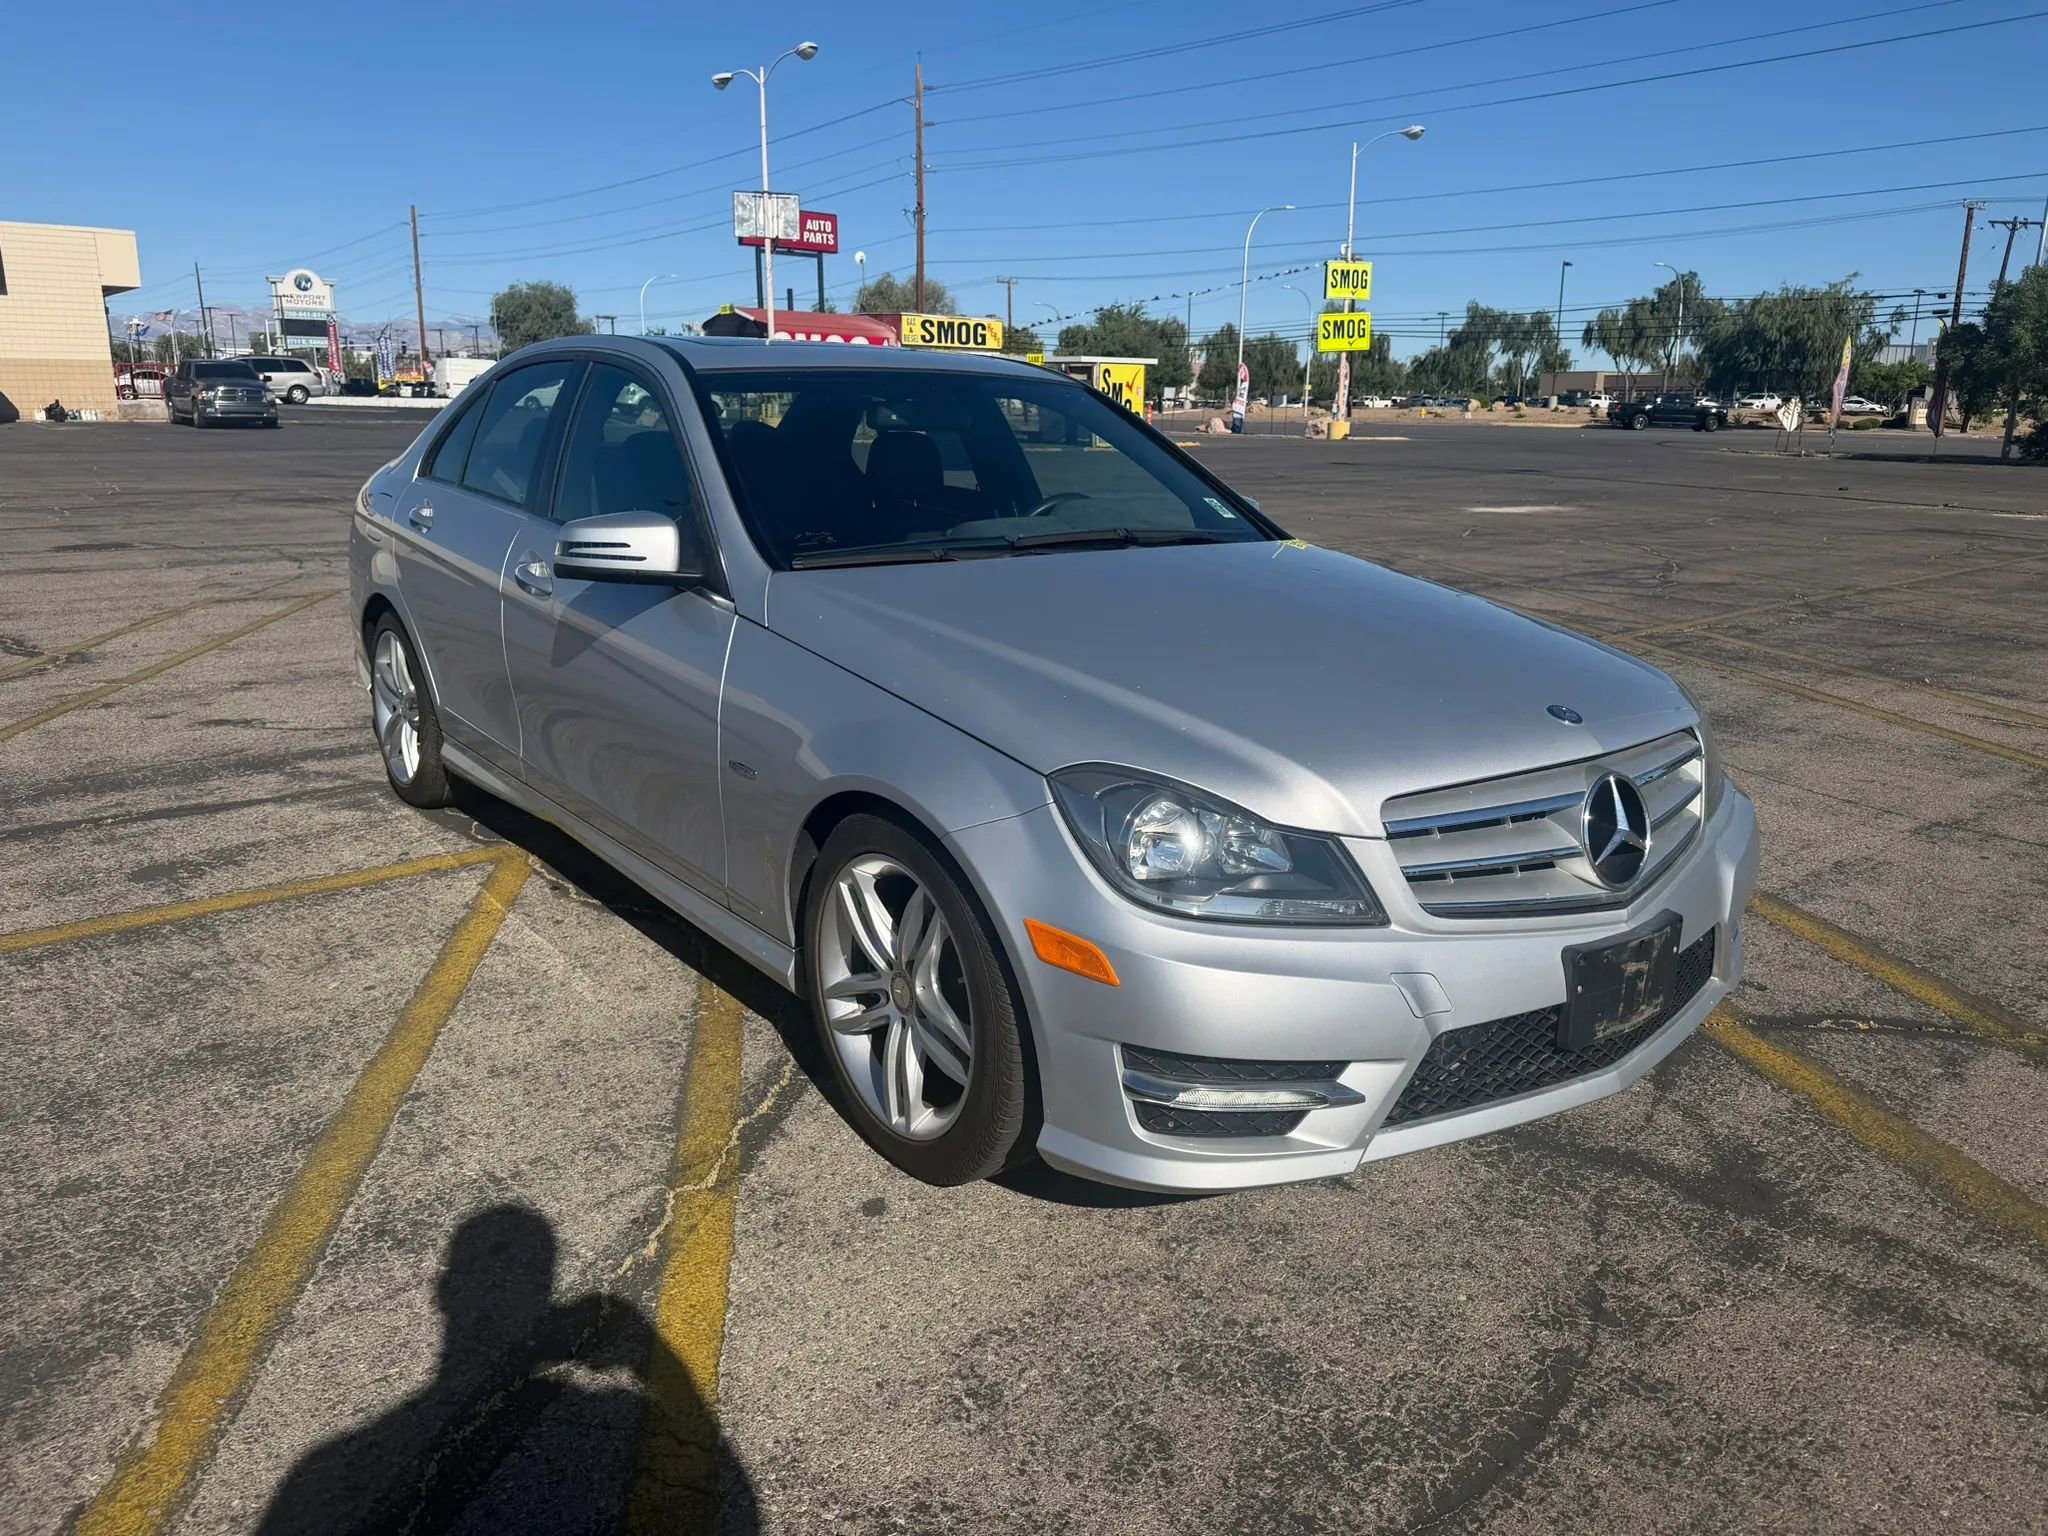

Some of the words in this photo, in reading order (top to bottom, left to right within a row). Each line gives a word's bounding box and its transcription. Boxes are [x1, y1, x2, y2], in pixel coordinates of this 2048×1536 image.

[806, 219, 832, 232] AUTO
[803, 231, 835, 245] PARTS
[1331, 269, 1368, 289] SMOG
[920, 319, 987, 346] SMOG
[1322, 319, 1366, 339] SMOG
